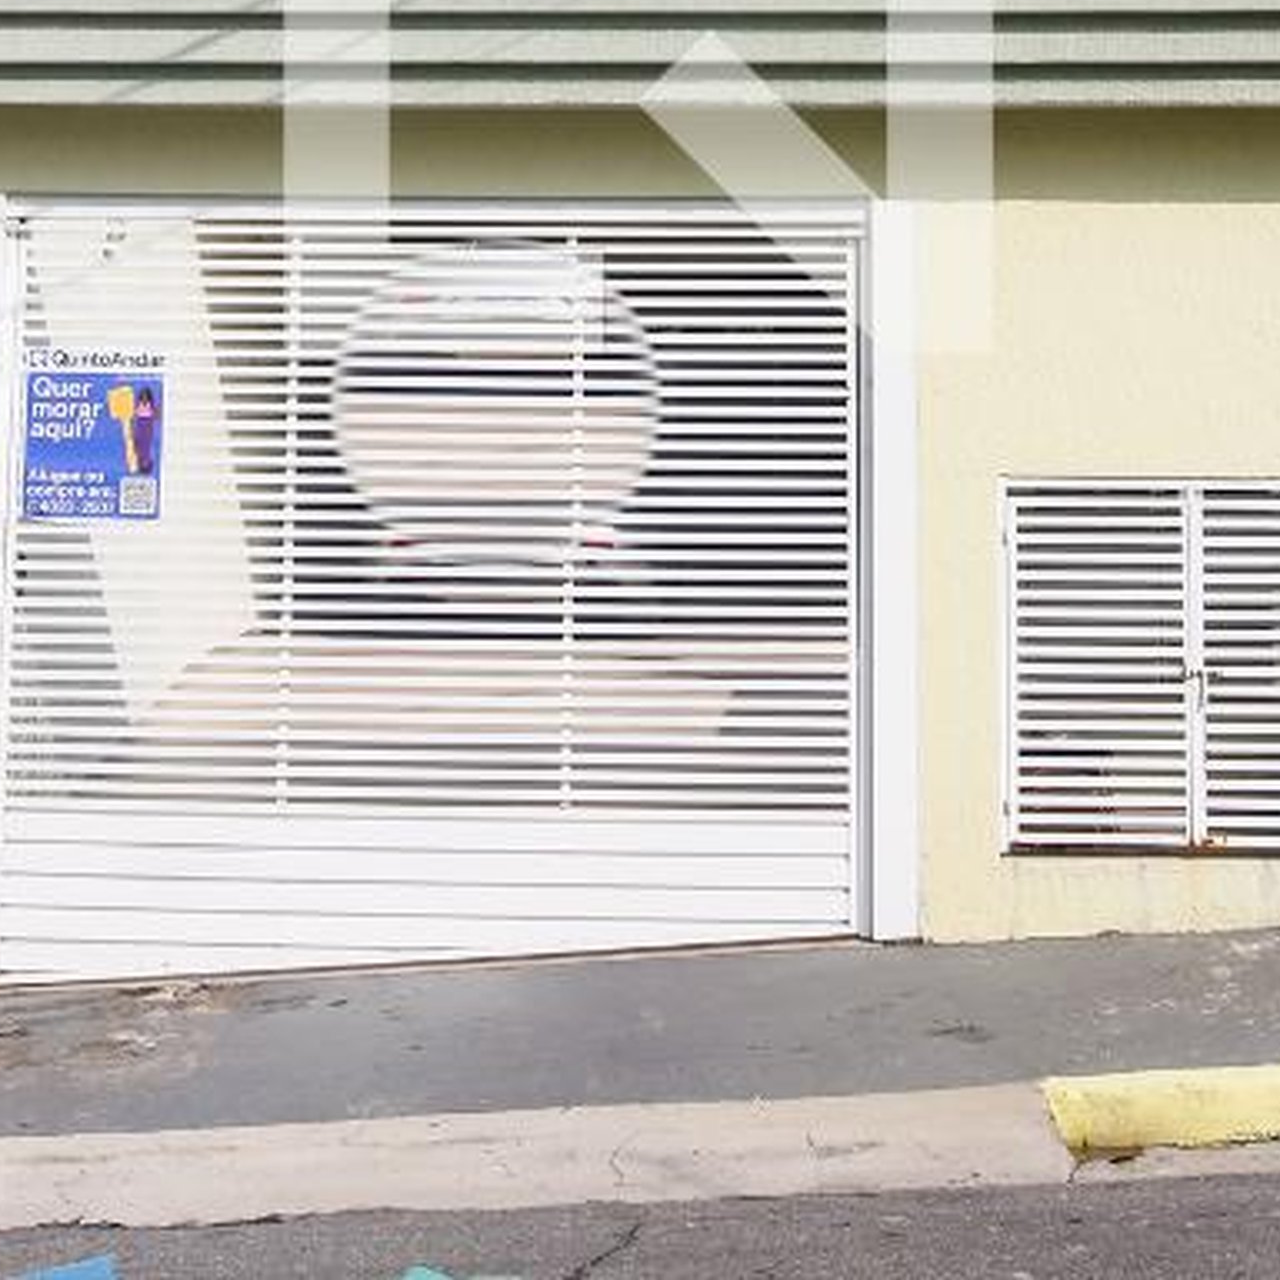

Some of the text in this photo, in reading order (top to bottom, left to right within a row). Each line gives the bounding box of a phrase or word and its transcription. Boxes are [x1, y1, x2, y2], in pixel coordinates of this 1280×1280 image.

[32, 375, 93, 398] Quer
[32, 402, 104, 418] morar
[29, 419, 95, 442] aqui?
